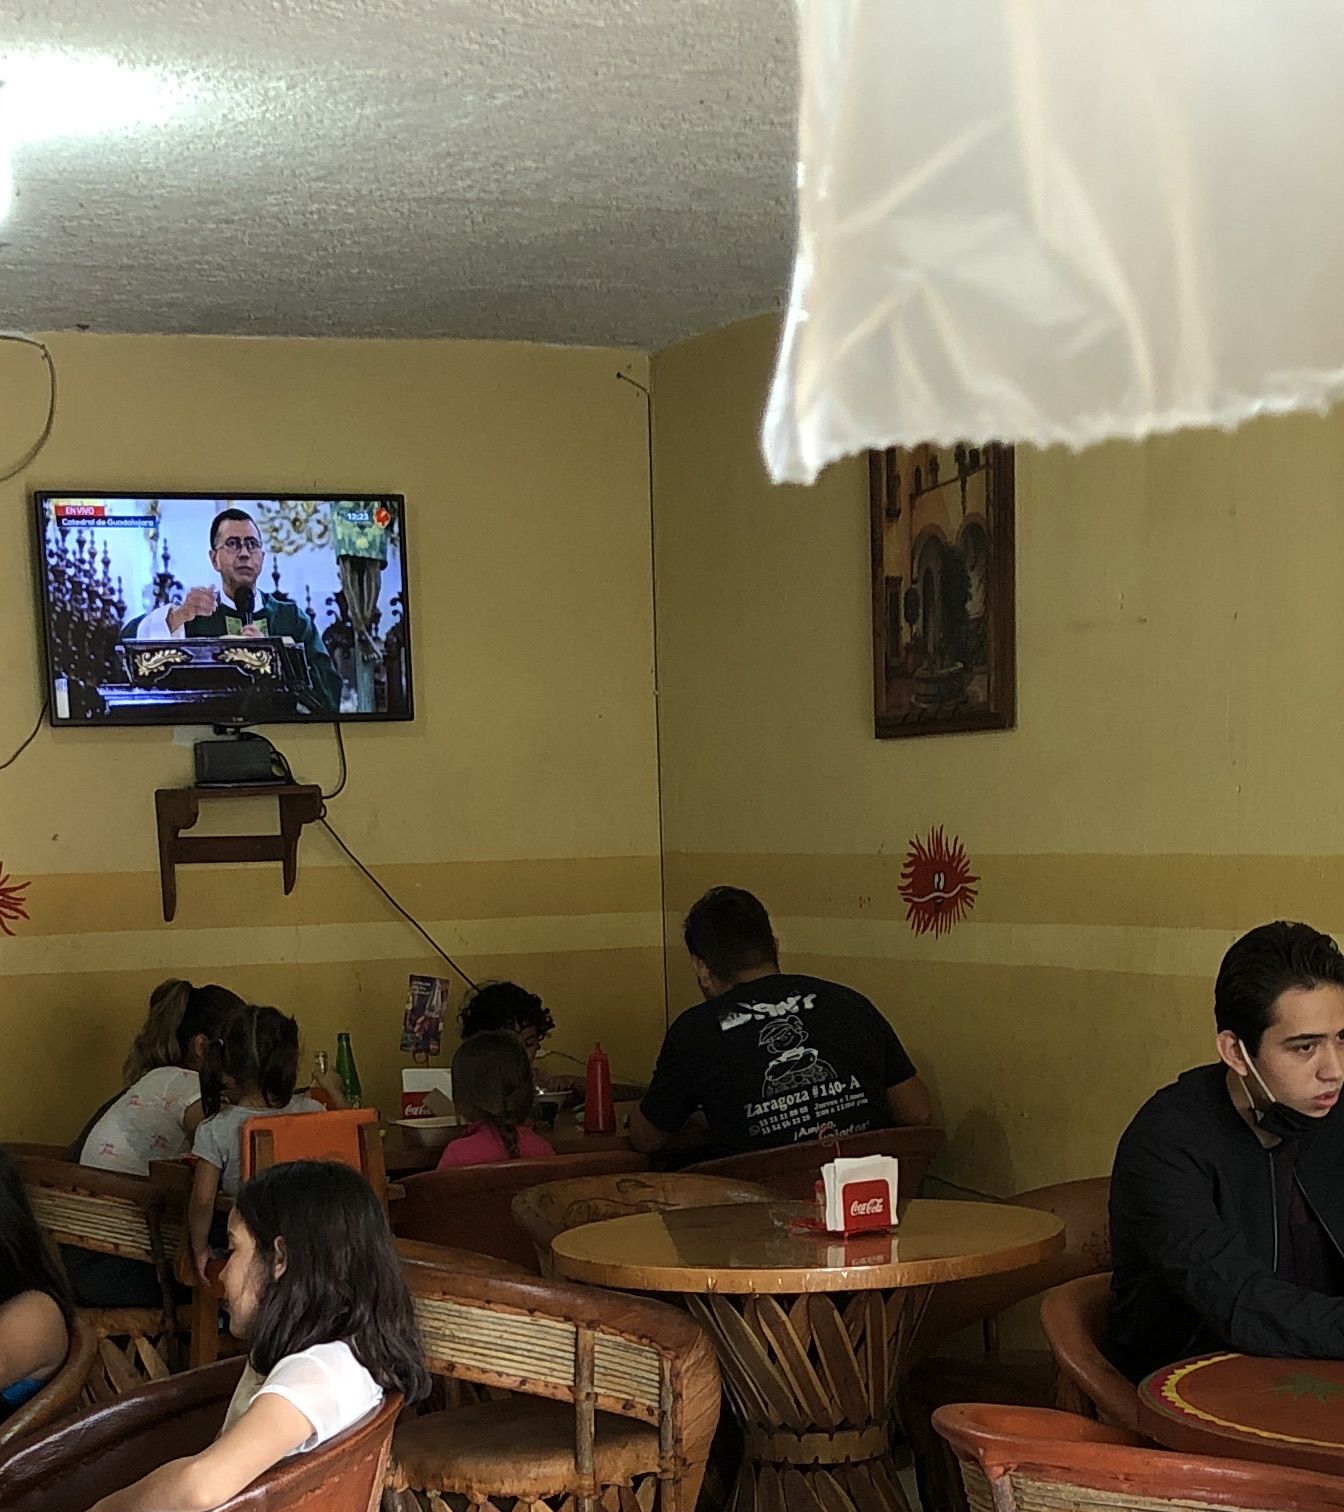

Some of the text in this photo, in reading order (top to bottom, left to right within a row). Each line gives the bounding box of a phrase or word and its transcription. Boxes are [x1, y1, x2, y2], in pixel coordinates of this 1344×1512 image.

[77, 507, 95, 516] VIVO
[743, 1090, 810, 1118] Zaragoza
[850, 1198, 884, 1216] Coca-Cola
